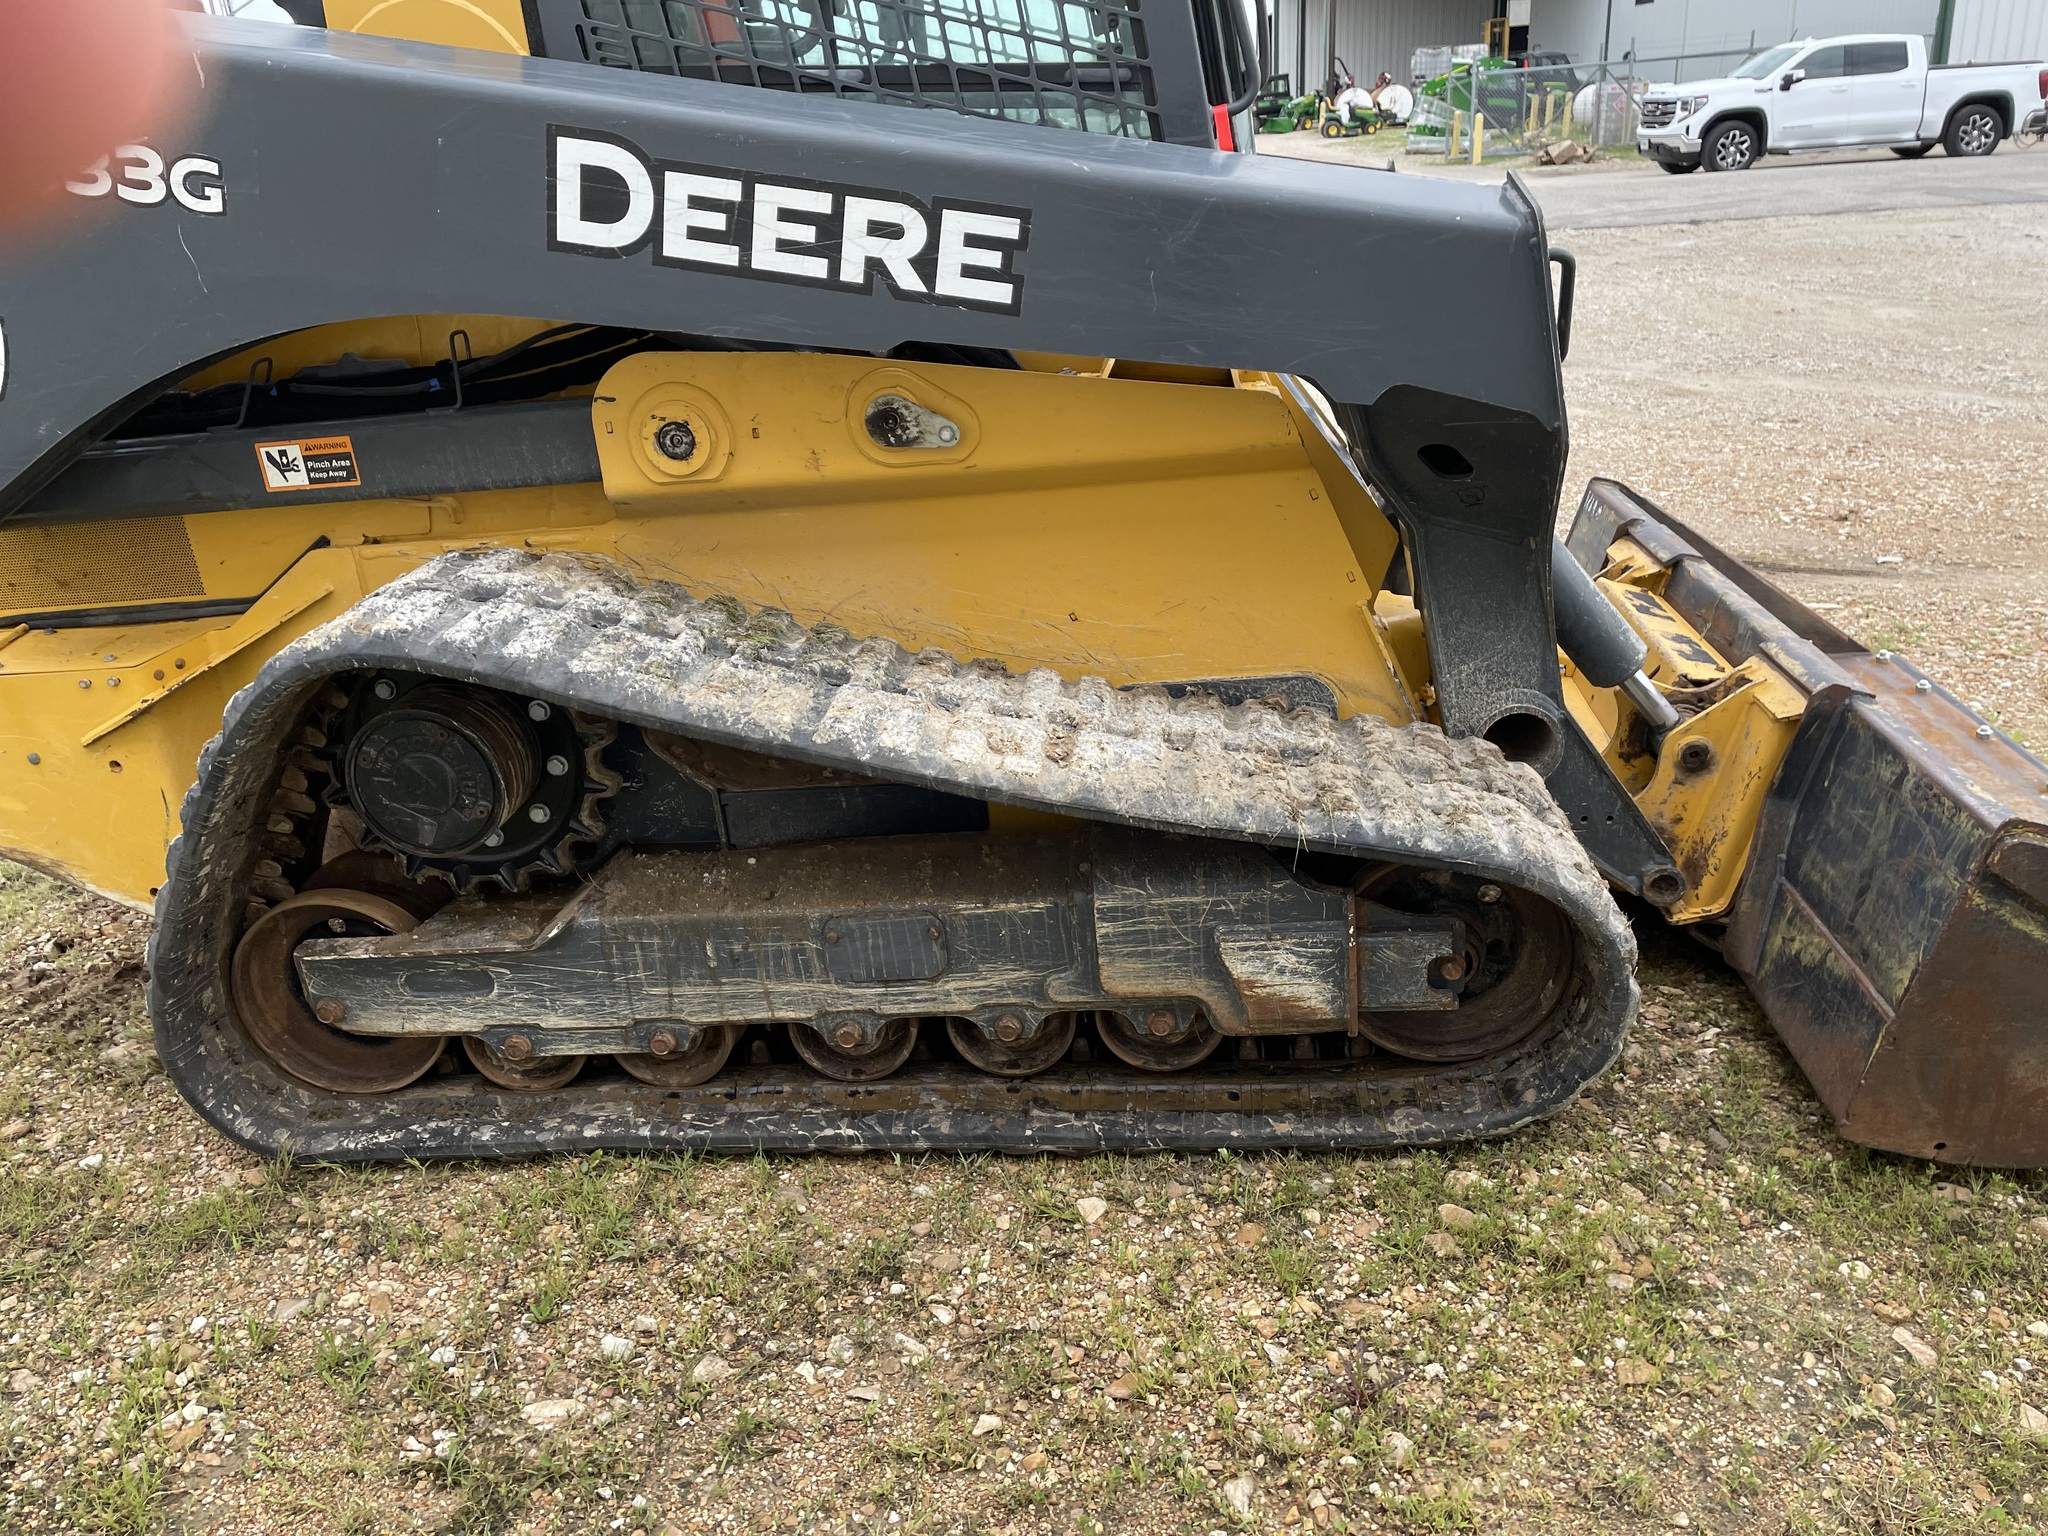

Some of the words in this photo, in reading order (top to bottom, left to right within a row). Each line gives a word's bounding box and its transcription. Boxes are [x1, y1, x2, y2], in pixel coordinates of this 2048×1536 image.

[556, 136, 1022, 304] DEERE
[311, 442, 348, 451] WARNING
[307, 461, 331, 469] Pinch
